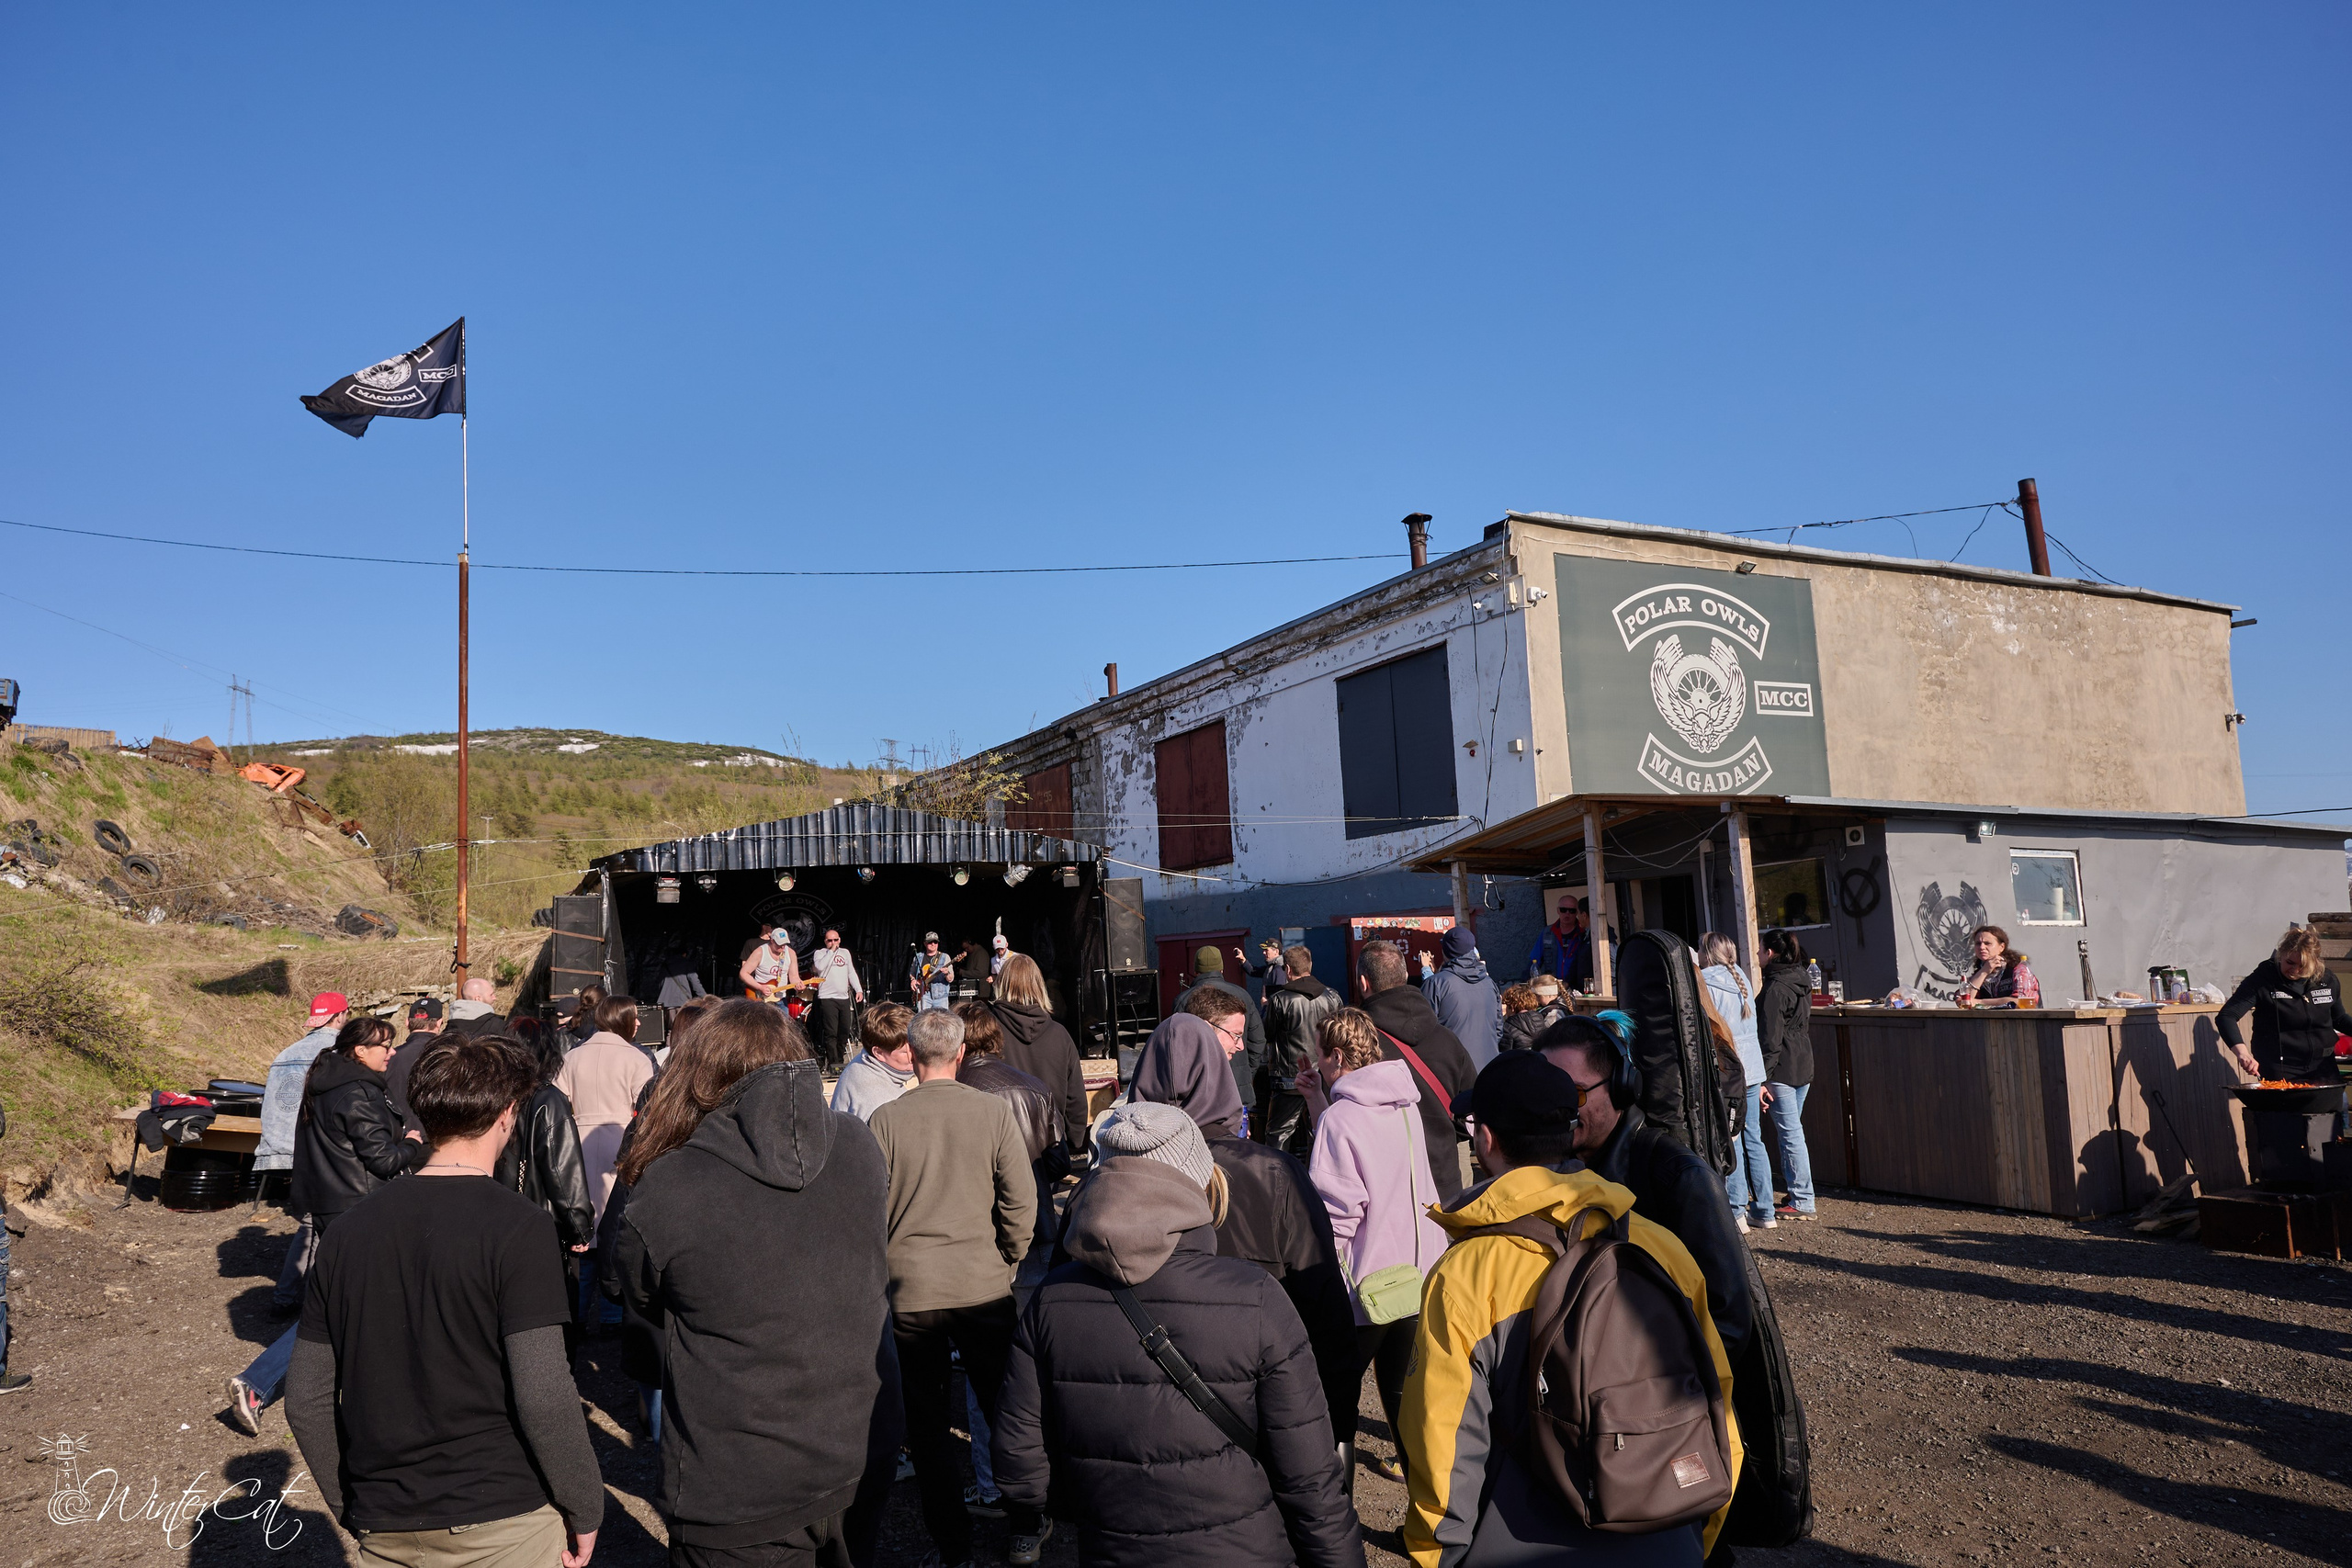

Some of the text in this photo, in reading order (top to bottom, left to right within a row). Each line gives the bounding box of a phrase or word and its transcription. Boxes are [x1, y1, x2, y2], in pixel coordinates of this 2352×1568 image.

[356, 389, 417, 402] MAGADAN
[1624, 596, 1759, 643] POLAR OWLS
[1758, 690, 1808, 707] MCC
[1648, 750, 1761, 793] MAGADAN
[756, 897, 827, 917] POLAR OWLS
